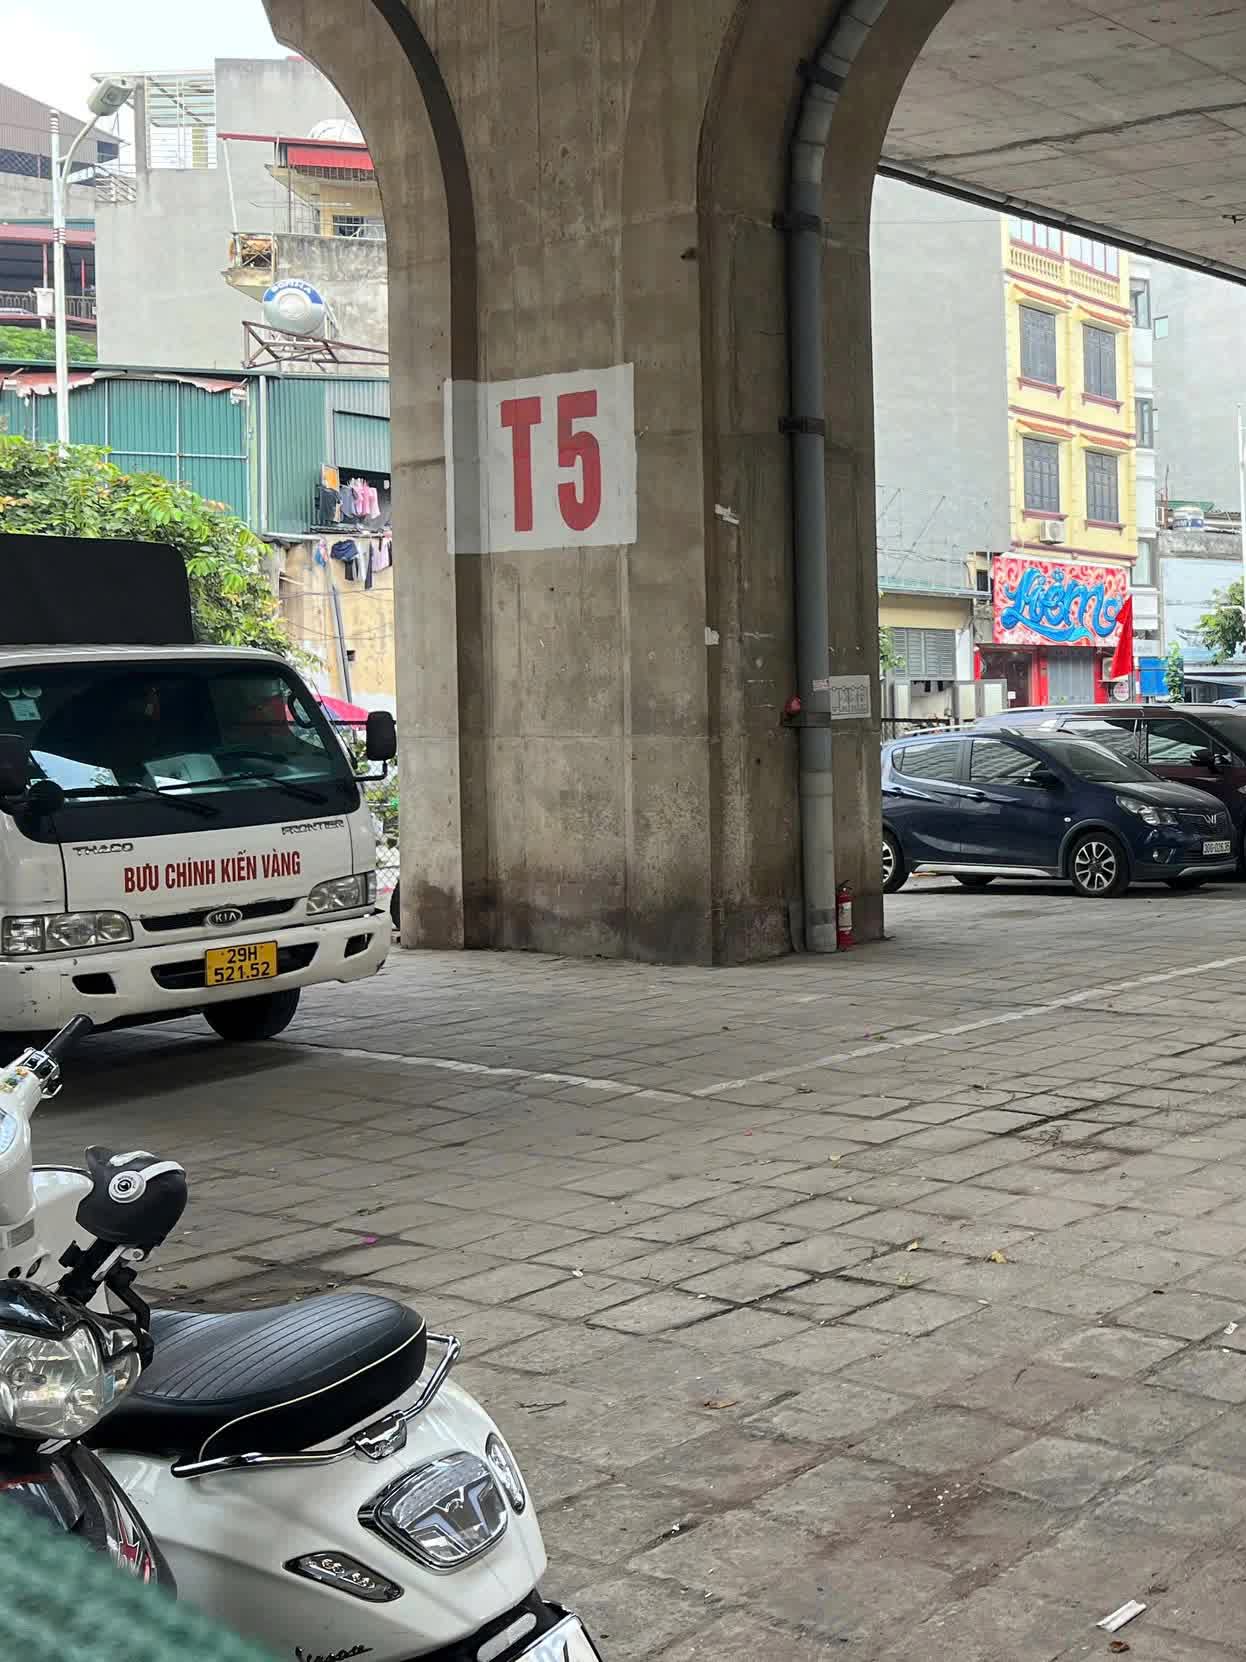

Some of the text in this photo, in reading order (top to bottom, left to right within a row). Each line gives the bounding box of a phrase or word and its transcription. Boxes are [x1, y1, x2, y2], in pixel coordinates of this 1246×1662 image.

[500, 390, 602, 532] T5
[281, 820, 344, 835] FRONTIER
[72, 843, 133, 856] THACO
[261, 848, 301, 878] VÀNG
[215, 912, 237, 922] KIA
[227, 946, 257, 964] 29H
[214, 961, 270, 982] 521.52
